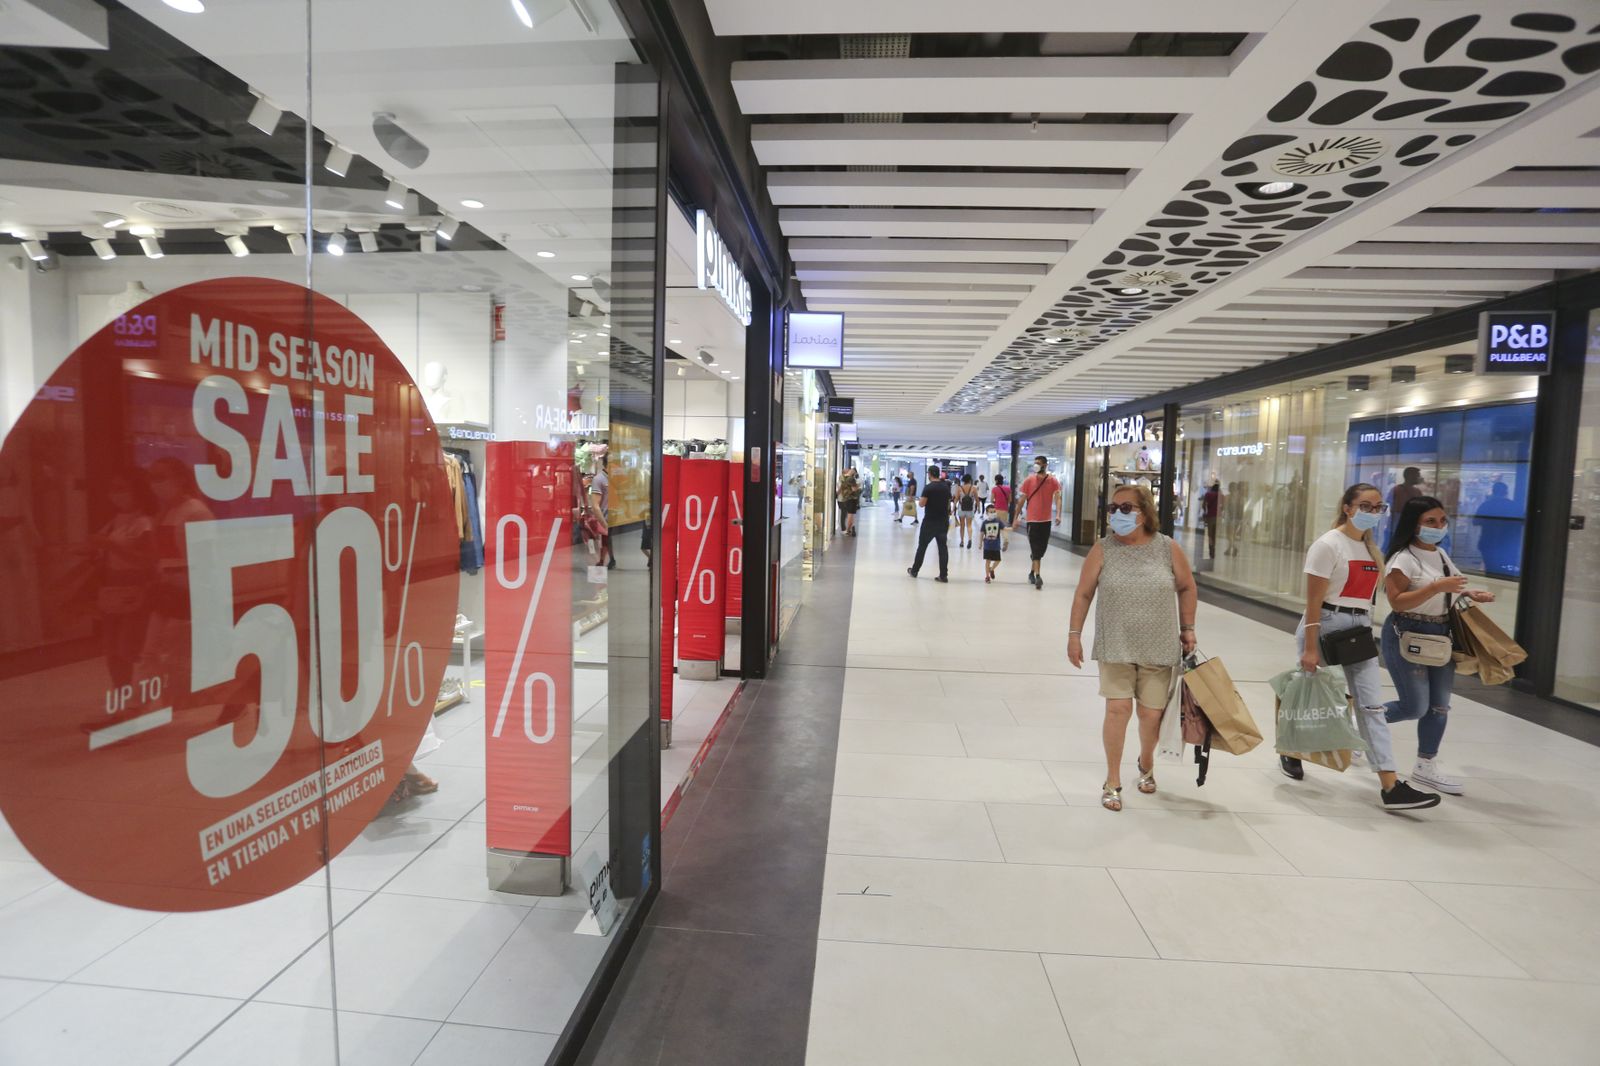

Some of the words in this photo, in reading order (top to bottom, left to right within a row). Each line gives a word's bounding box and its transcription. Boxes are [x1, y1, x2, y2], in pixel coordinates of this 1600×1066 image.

[190, 313, 259, 372] MID
[269, 332, 375, 391] SEASON
[1490, 324, 1548, 349] P&B
[1490, 352, 1546, 363] PULL&BEAR
[192, 375, 376, 501] SALE
[1089, 414, 1145, 449] PULL&BEAR
[105, 684, 133, 714] UP
[139, 676, 162, 701] TO
[205, 831, 223, 851] EN
[226, 818, 255, 839] UNA
[256, 780, 317, 822] SELECCIÓN
[207, 861, 231, 886] EN
[233, 831, 289, 869] TIENDA
[289, 816, 299, 836] Y
[302, 806, 320, 830] EN
